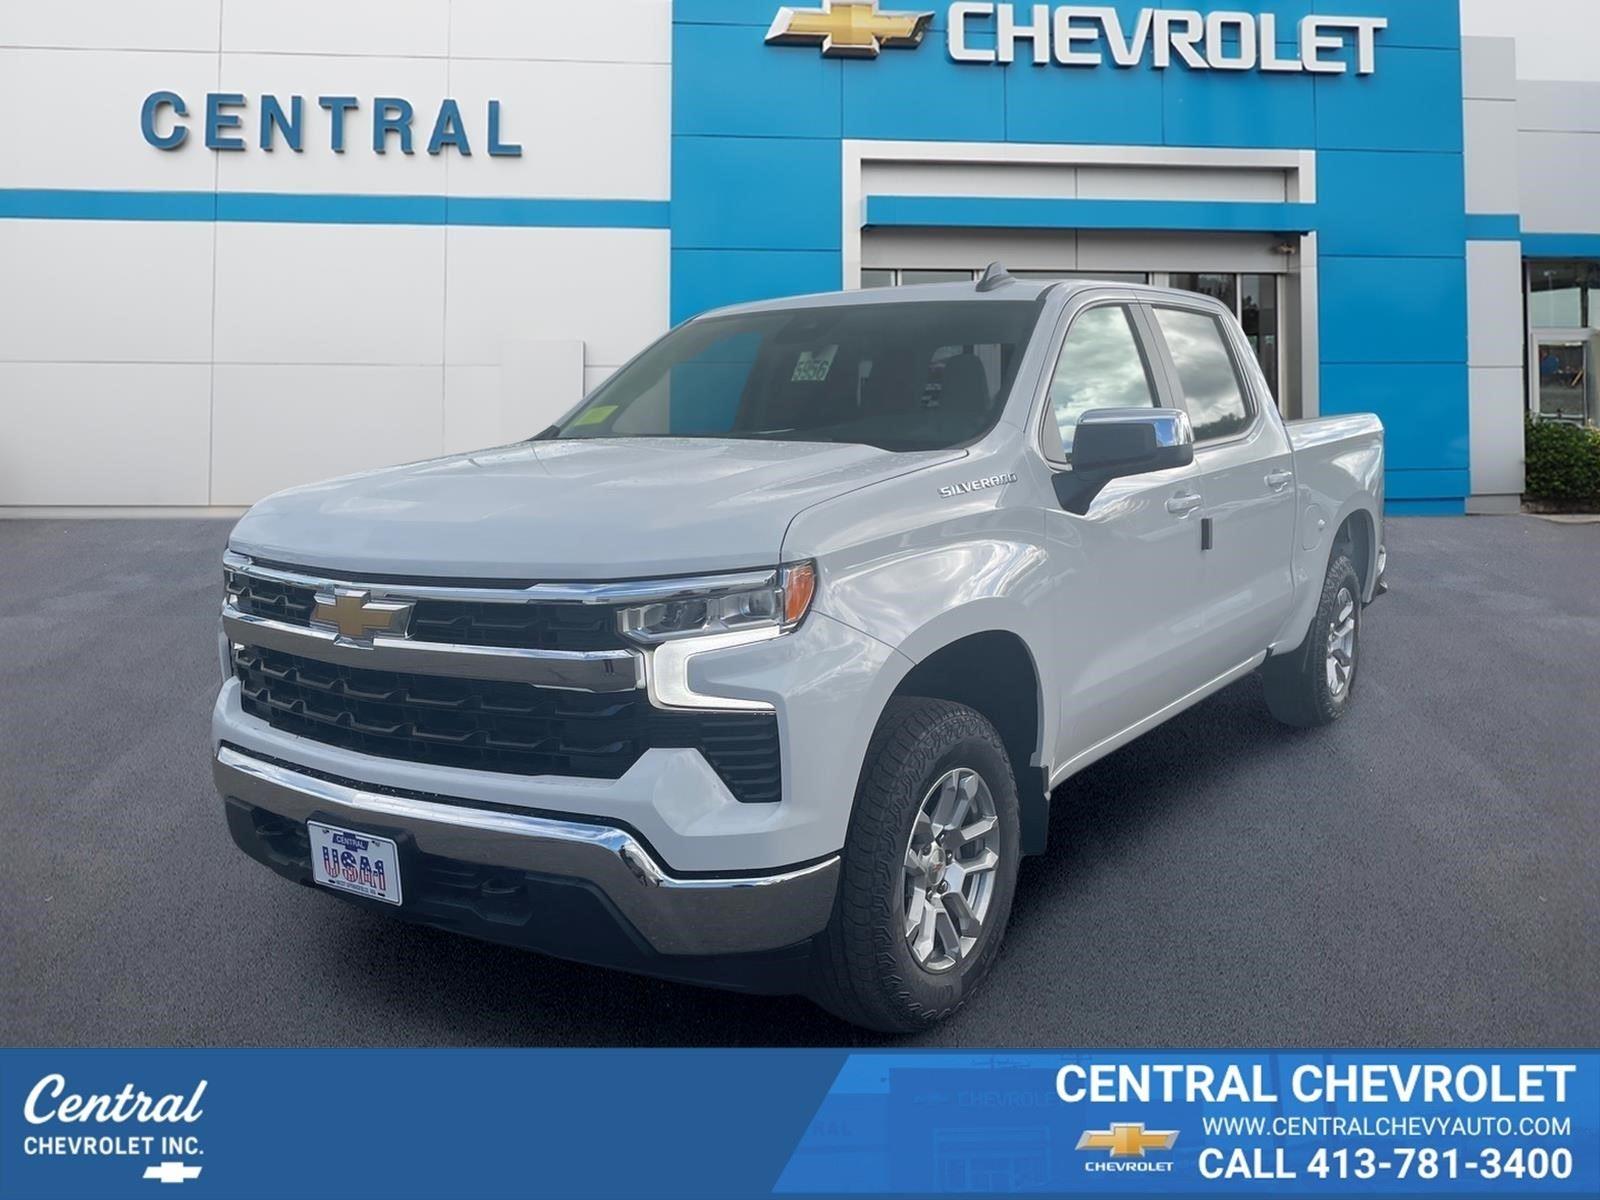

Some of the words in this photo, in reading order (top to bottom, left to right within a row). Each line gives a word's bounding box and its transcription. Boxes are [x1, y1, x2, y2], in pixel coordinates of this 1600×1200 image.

[946, 1, 1388, 75] CHEVROLET
[140, 90, 523, 157] CENTRAL
[938, 472, 1018, 498] SILVERADO
